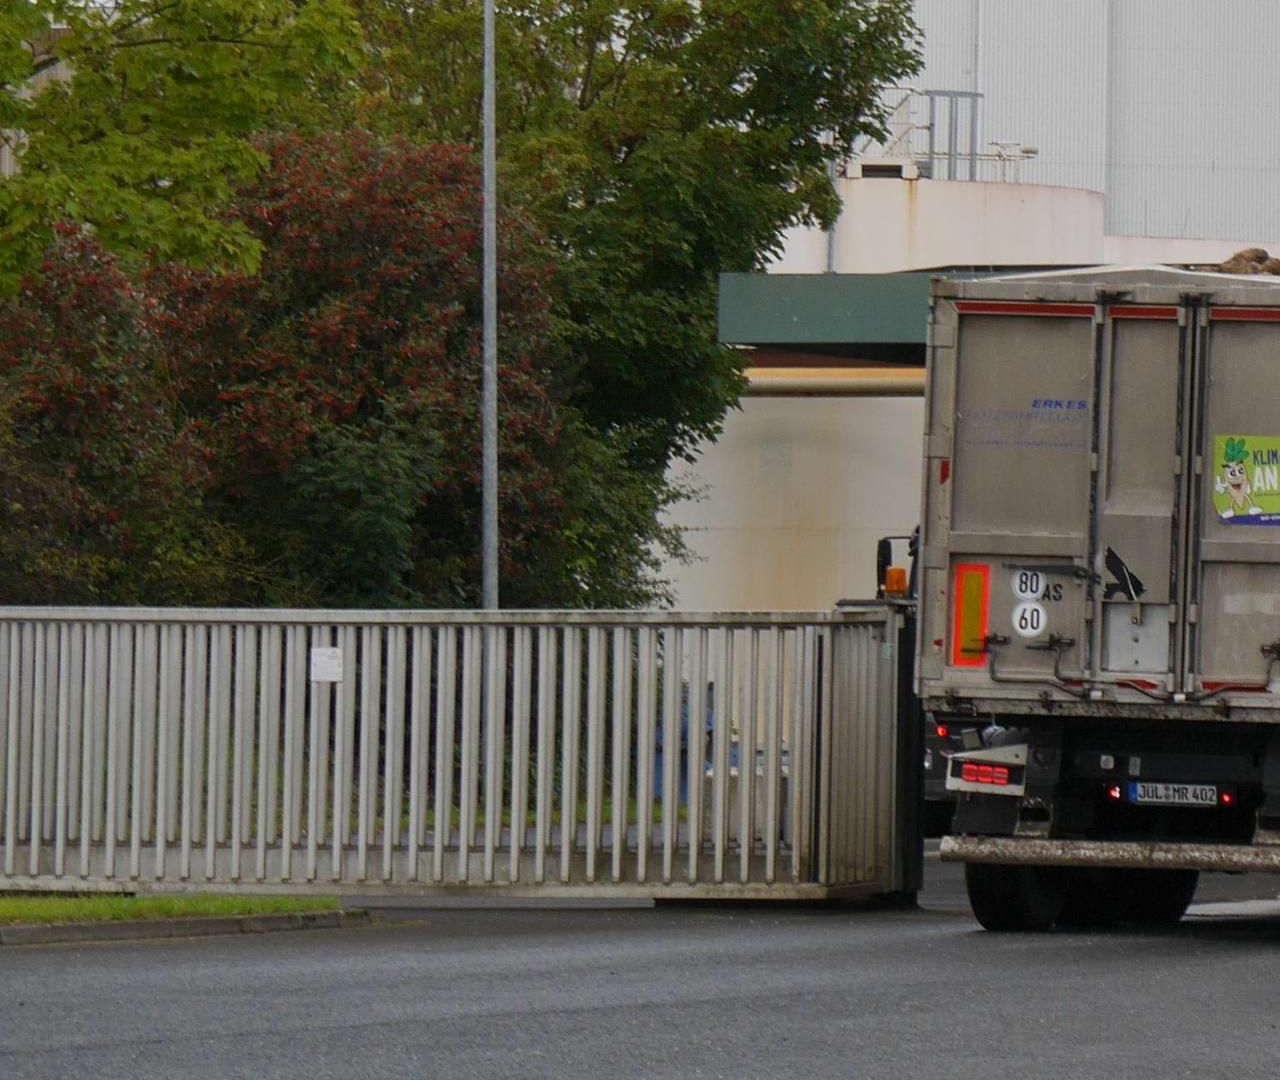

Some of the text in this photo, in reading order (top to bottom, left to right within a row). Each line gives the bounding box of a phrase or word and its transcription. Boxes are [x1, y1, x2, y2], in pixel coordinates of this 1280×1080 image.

[1031, 400, 1087, 409] ERKES
[1253, 465, 1278, 492] AN
[1019, 572, 1040, 594] 80
[1018, 608, 1040, 630] 60
[1172, 786, 1189, 801] MR
[1192, 788, 1216, 802] 402
